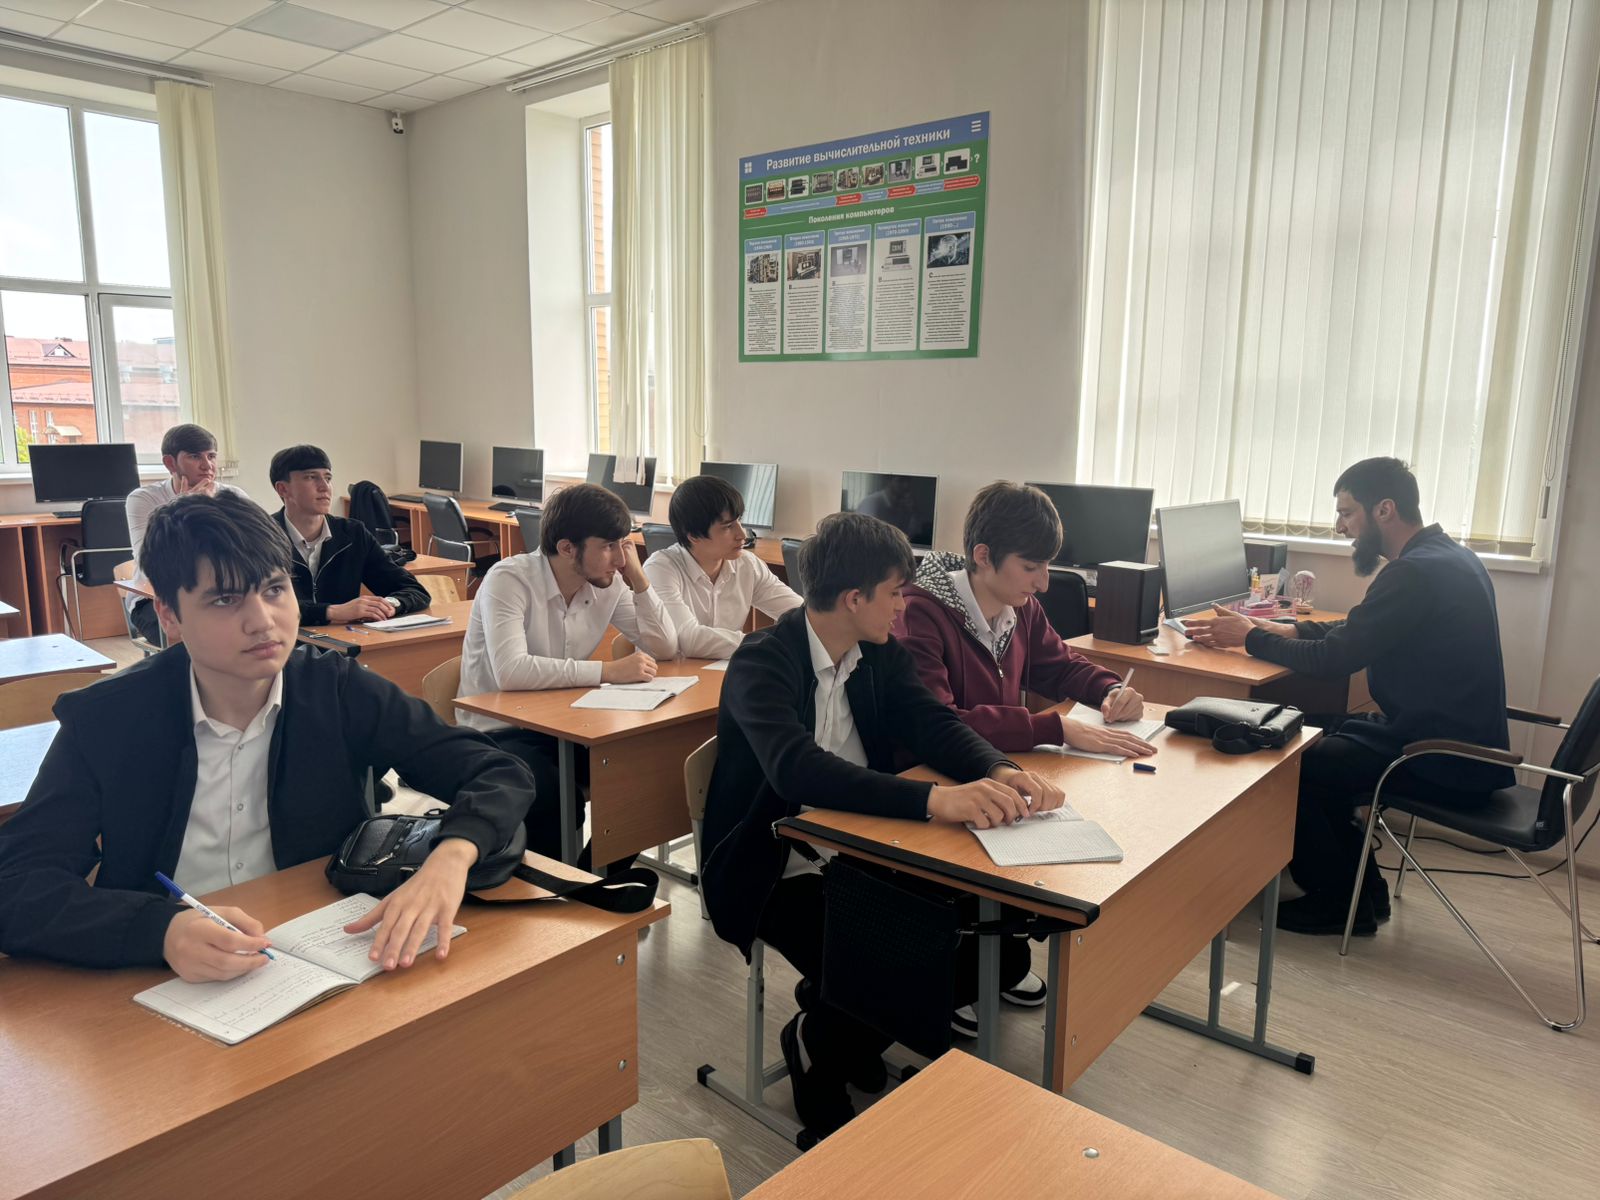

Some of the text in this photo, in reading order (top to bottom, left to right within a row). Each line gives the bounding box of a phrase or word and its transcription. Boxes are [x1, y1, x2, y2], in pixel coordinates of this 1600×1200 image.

[766, 129, 951, 171] Развитие вычислительной техники
[845, 206, 895, 221] компьютеров
